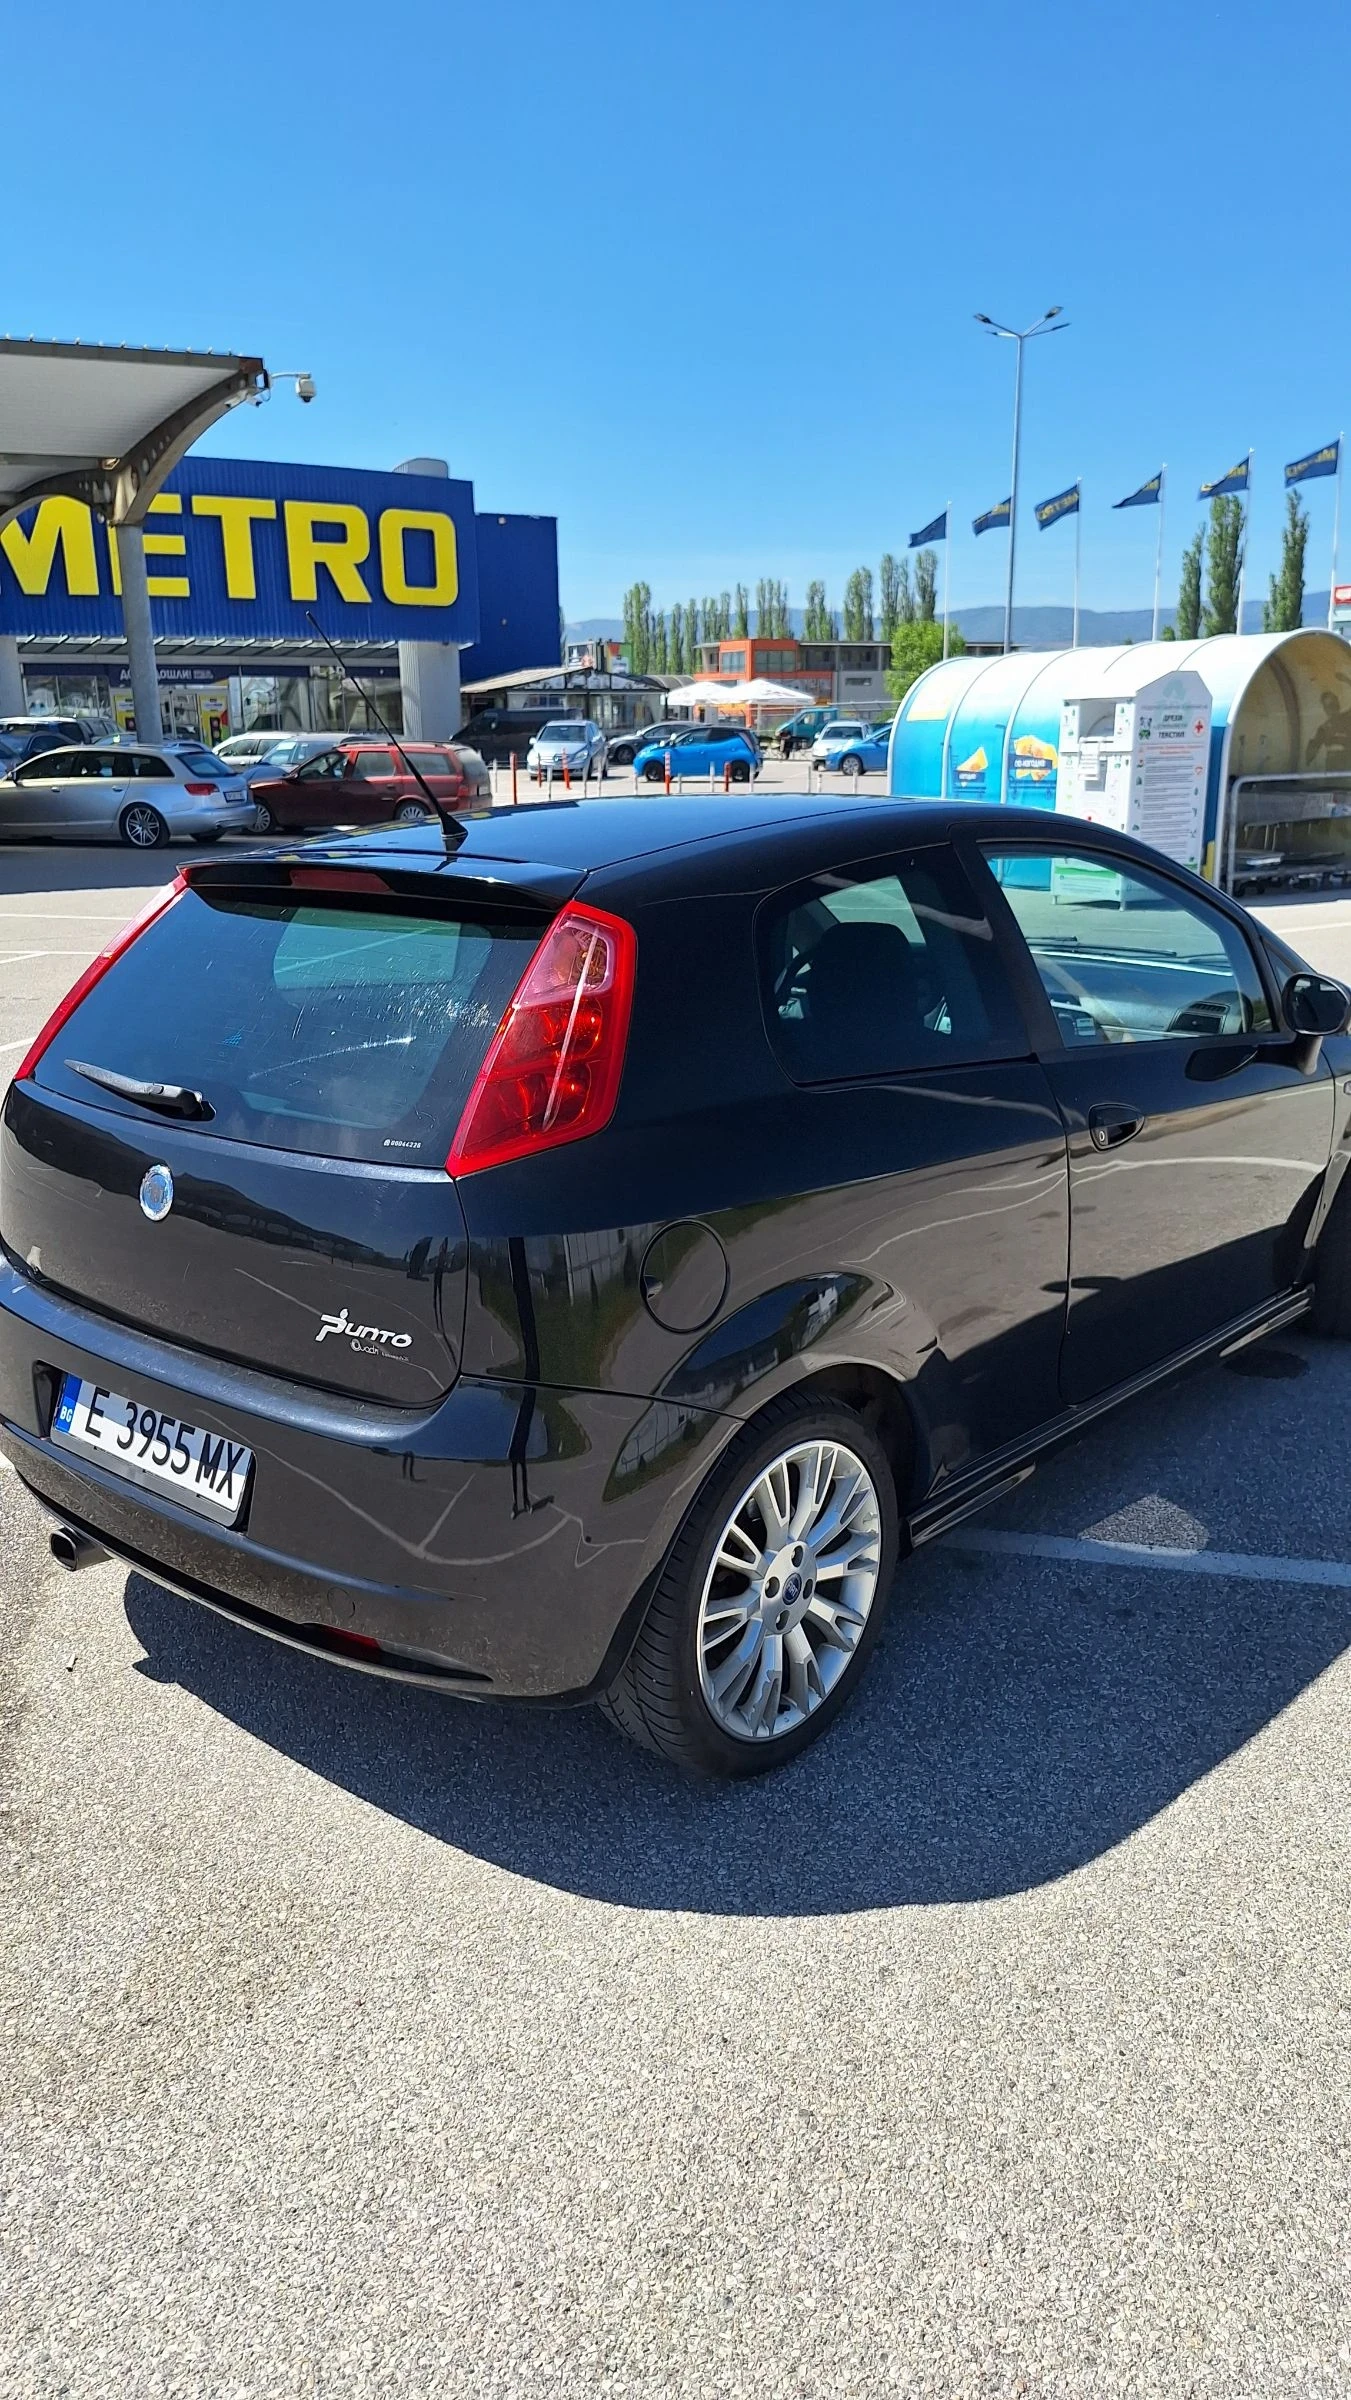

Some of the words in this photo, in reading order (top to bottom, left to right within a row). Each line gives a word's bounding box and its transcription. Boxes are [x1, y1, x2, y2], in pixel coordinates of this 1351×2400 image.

[0, 494, 459, 607] METRO
[158, 668, 192, 680] ОШЛИ!
[60, 1406, 73, 1423] BG
[85, 1386, 110, 1438] E
[117, 1401, 196, 1475] 3955
[195, 1433, 246, 1500] MX
